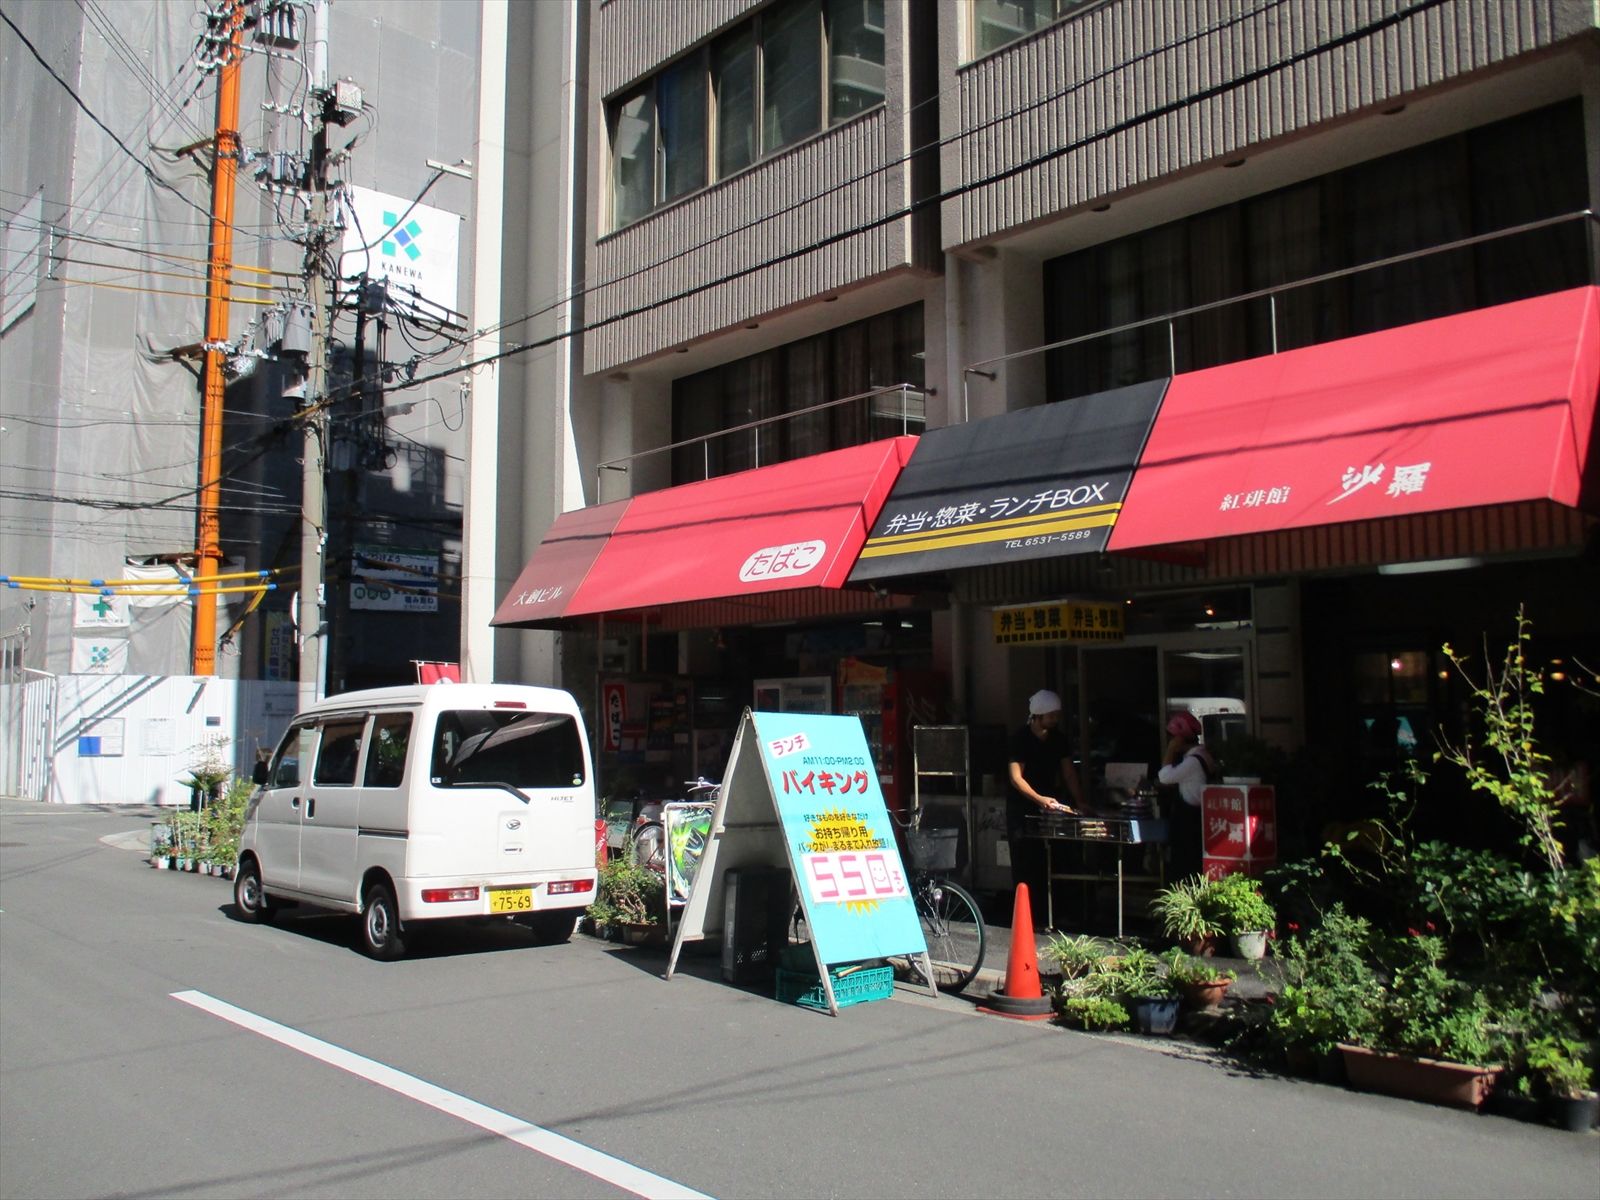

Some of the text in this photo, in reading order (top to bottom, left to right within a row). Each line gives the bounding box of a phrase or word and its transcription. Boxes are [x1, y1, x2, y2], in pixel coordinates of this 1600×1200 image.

[381, 261, 423, 280] KANEWA
[1326, 462, 1431, 506] 沙羅
[883, 481, 1110, 535] 弁当・惣菜・ランチBOX
[1005, 530, 1091, 549] TEL 6531-5589
[744, 546, 817, 577] たばこ
[772, 735, 805, 756] ランチ
[782, 770, 869, 795] バイキング
[803, 813, 869, 823] 好きなものを好きなだけ
[814, 826, 869, 839] お持ち帰り用
[810, 854, 894, 898] 550
[499, 895, 531, 910] 75-69
